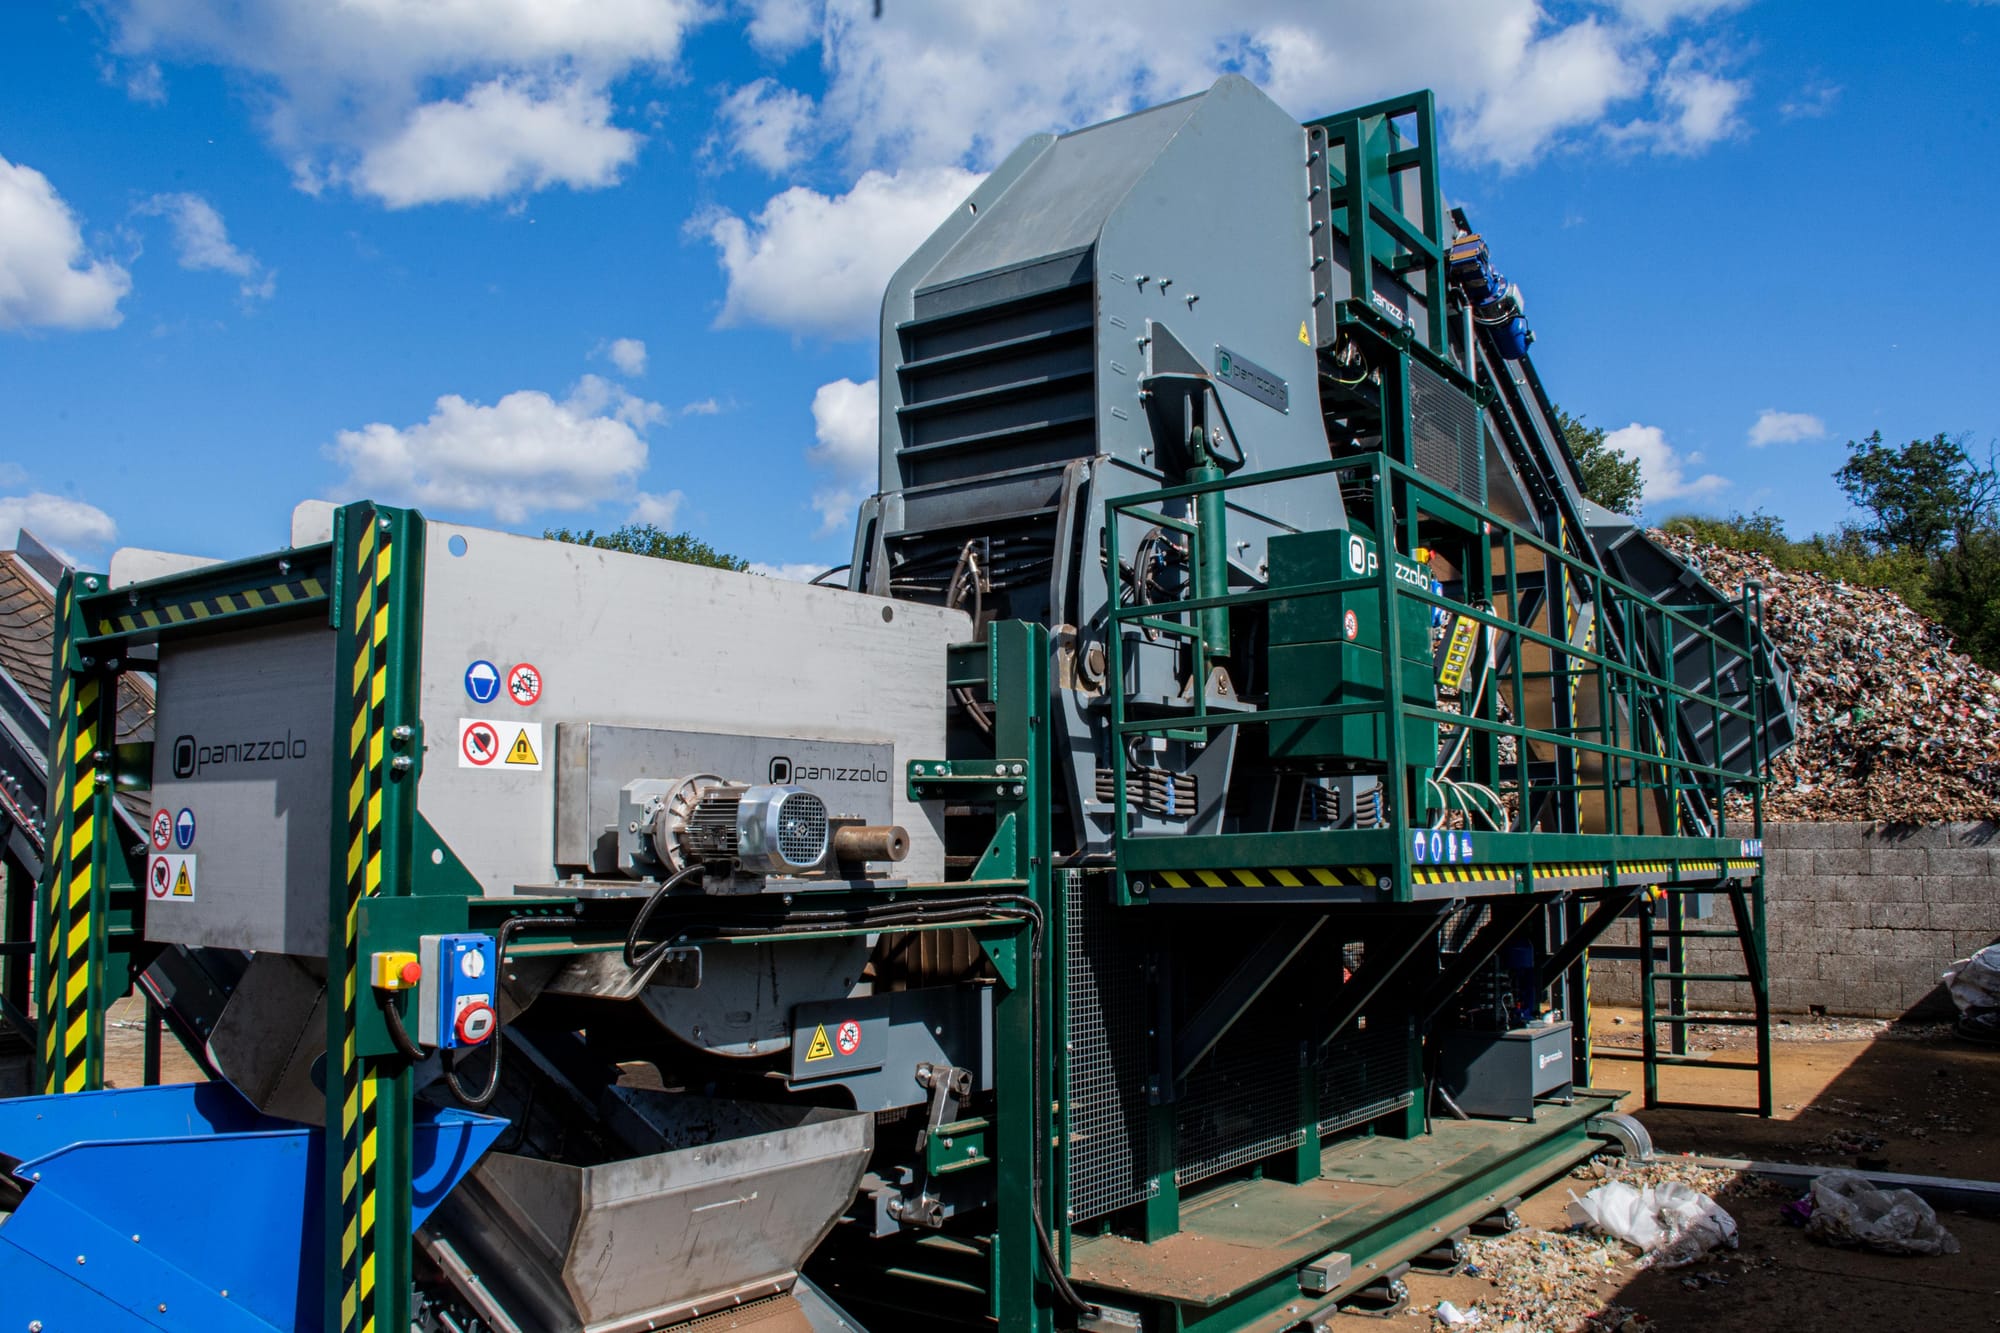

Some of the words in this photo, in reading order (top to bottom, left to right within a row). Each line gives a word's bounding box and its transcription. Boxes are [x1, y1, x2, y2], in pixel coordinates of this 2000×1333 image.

[1368, 552, 1429, 591] pzzolo
[198, 728, 307, 775] panizzolo
[794, 763, 888, 785] panizzolo
